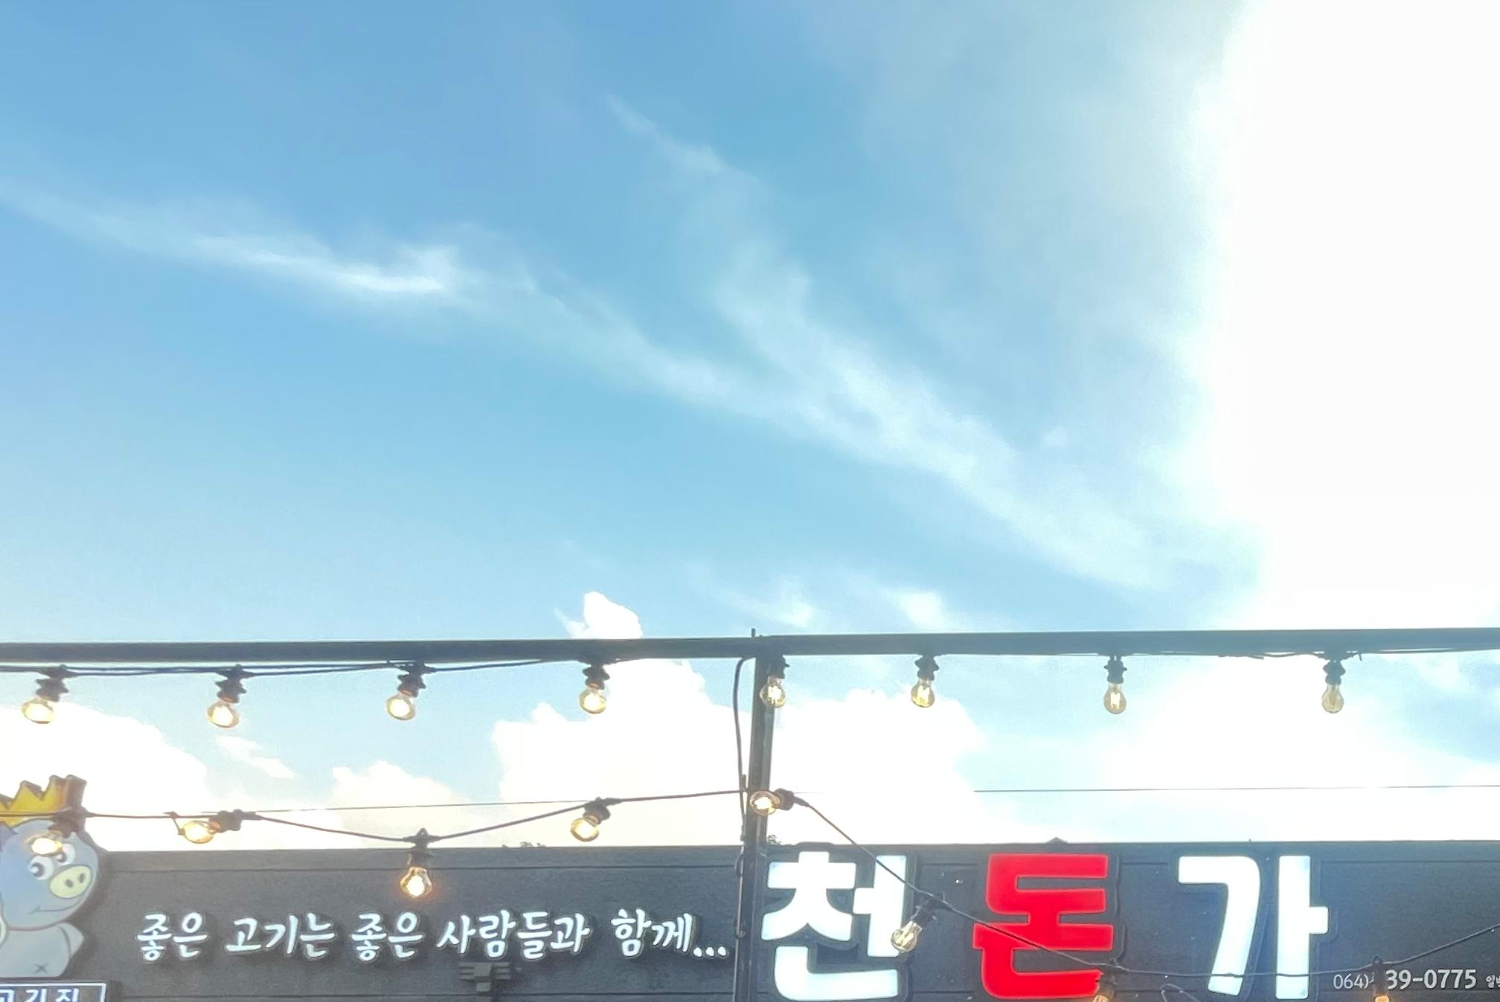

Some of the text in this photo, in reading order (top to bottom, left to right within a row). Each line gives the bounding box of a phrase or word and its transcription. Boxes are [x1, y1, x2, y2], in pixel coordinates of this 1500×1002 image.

[137, 912, 207, 961] 좋은
[225, 912, 335, 958] 고기는
[351, 912, 423, 961] 좋은
[437, 909, 590, 959] 사람들과
